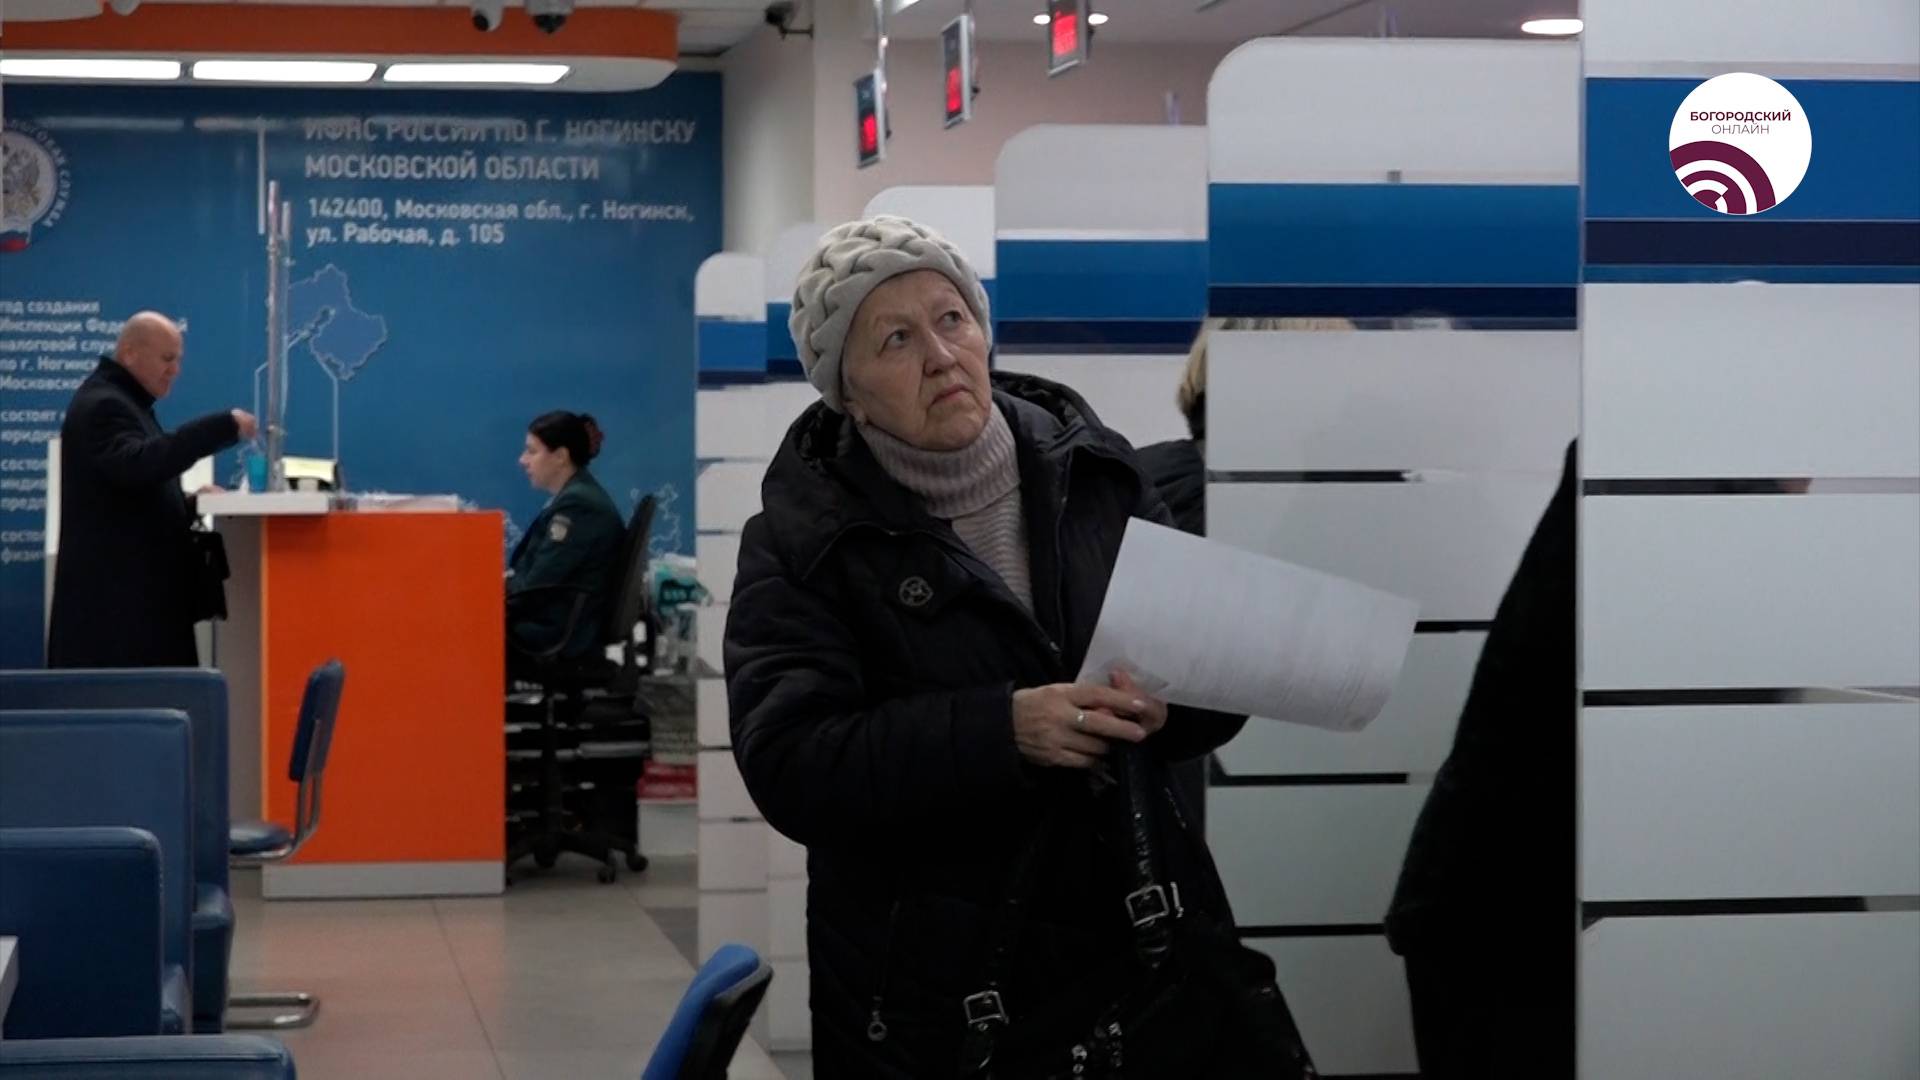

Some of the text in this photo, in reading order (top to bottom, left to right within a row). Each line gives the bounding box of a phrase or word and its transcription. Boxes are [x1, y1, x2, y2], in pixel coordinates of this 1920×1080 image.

[304, 117, 696, 144] ИФНС РОССИИ ПО Г. НОГИНСКУ
[304, 151, 600, 180] МОСКОВСКОЙ ОБЛАСТИ
[308, 198, 389, 221] 142400,
[395, 199, 518, 220] Московская
[578, 203, 597, 219] г.
[603, 200, 696, 222] Ногинск,
[306, 222, 505, 248] ул. Рабочая, д. 105
[28, 301, 100, 315] создания
